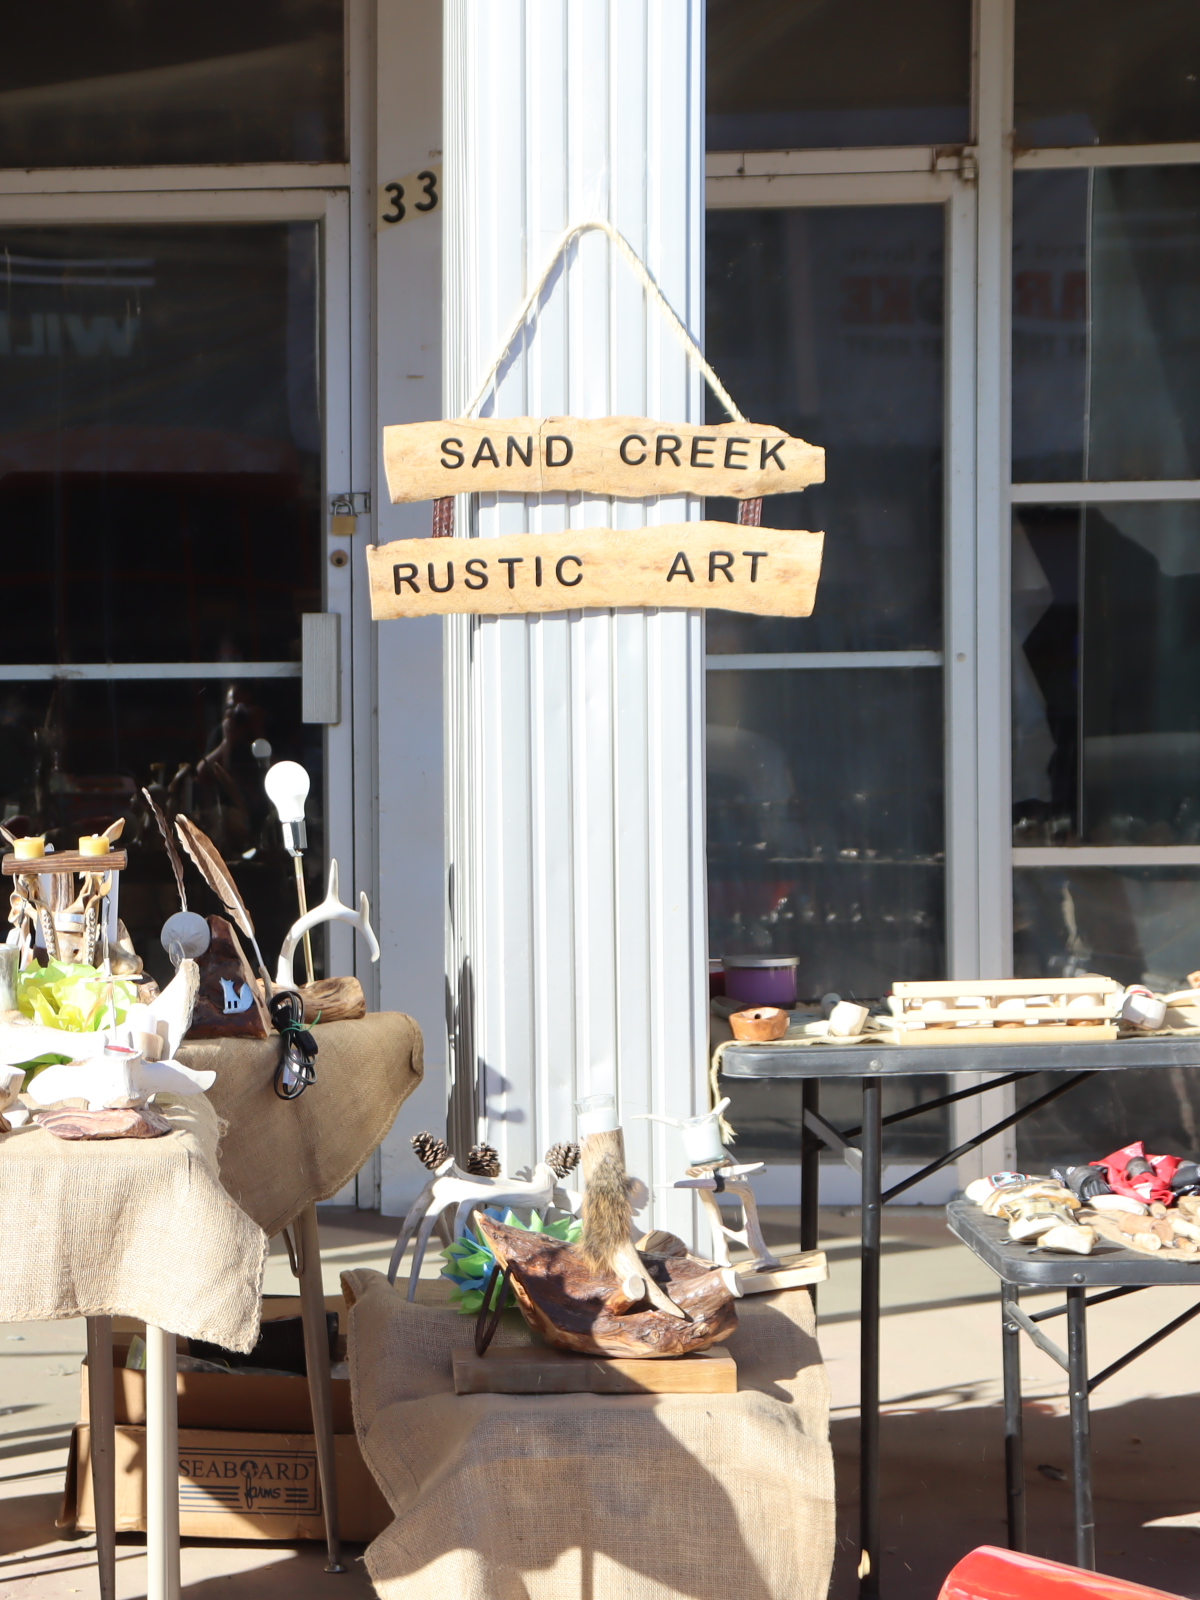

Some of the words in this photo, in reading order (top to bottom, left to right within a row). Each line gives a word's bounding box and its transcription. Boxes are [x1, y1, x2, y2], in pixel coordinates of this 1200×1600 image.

[381, 170, 439, 223] 33
[439, 436, 574, 469] SAND
[619, 435, 787, 471] CREEK
[392, 555, 584, 595] RUSTIC
[666, 551, 769, 584] ART
